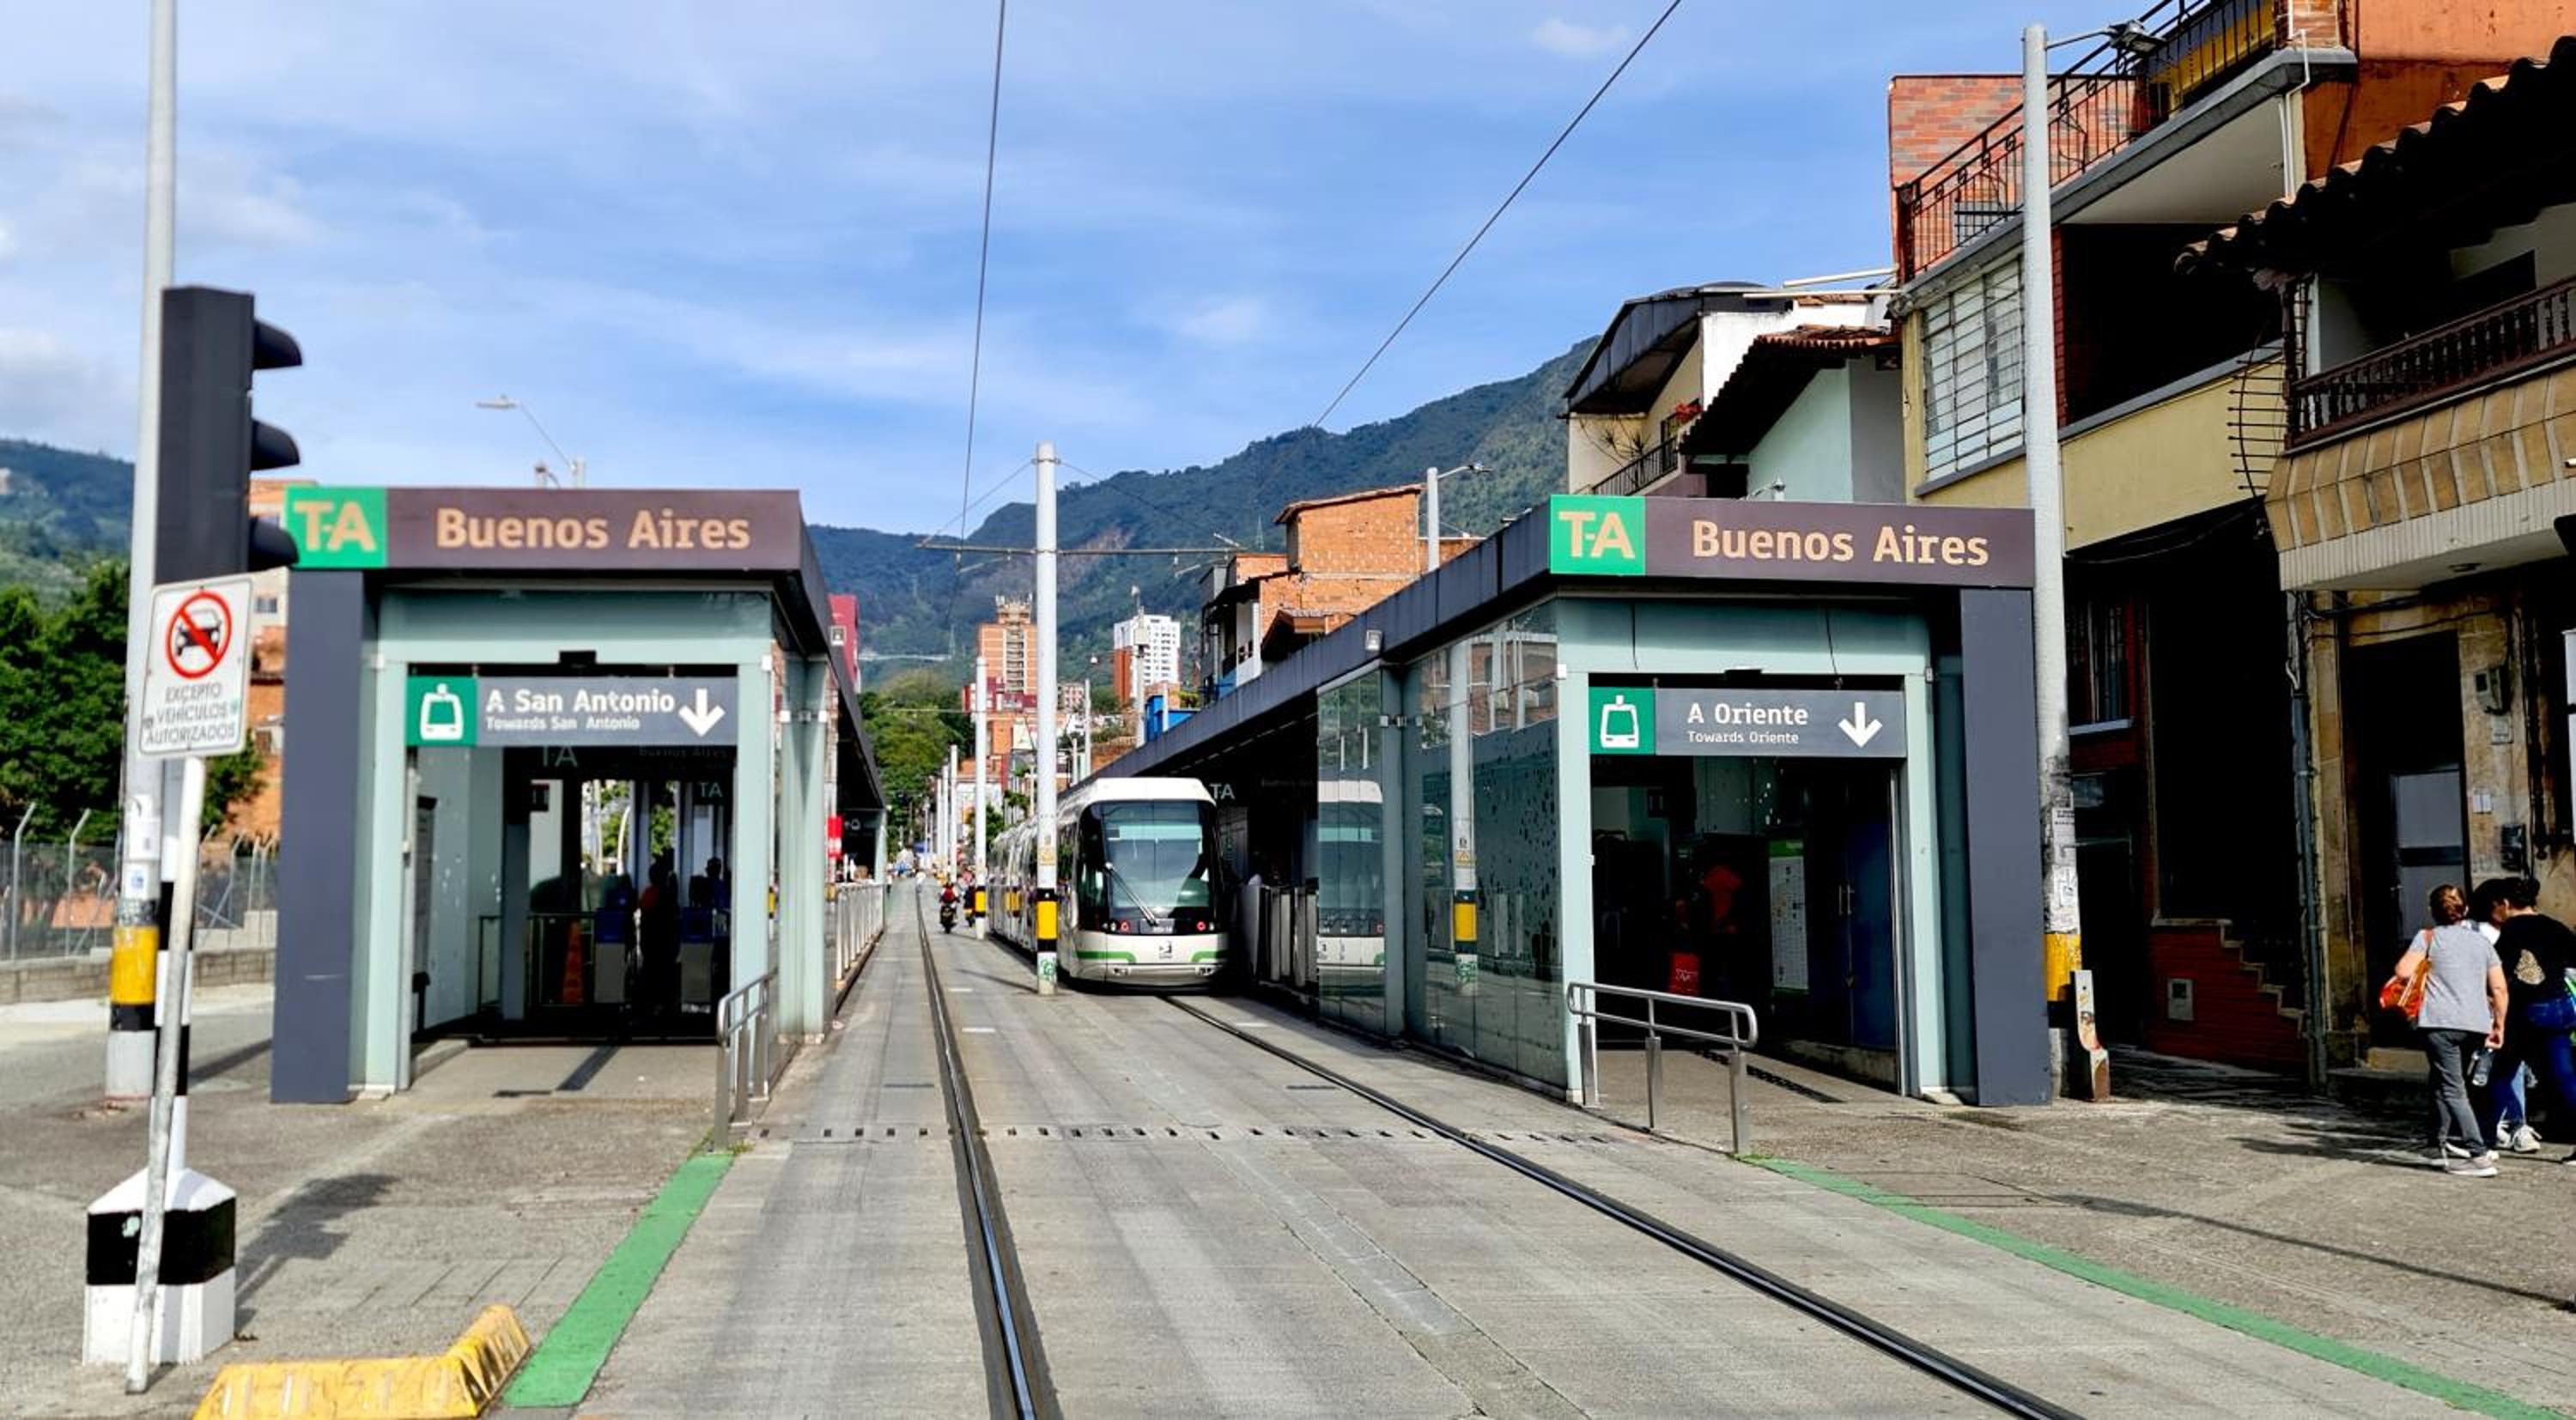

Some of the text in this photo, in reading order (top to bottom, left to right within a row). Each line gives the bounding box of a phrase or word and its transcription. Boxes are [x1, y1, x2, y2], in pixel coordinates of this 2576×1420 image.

[436, 508, 751, 550] Buenos Aires
[1692, 520, 1989, 567] Buenos Aires
[165, 683, 222, 702] EXCEPTO
[485, 688, 675, 713] A San Antonio
[486, 714, 641, 731] Towards San Antonio
[1687, 702, 1808, 725] A Oriente
[145, 721, 235, 745] AUTORIZADOS
[1687, 731, 1799, 743] Towards Oriente
